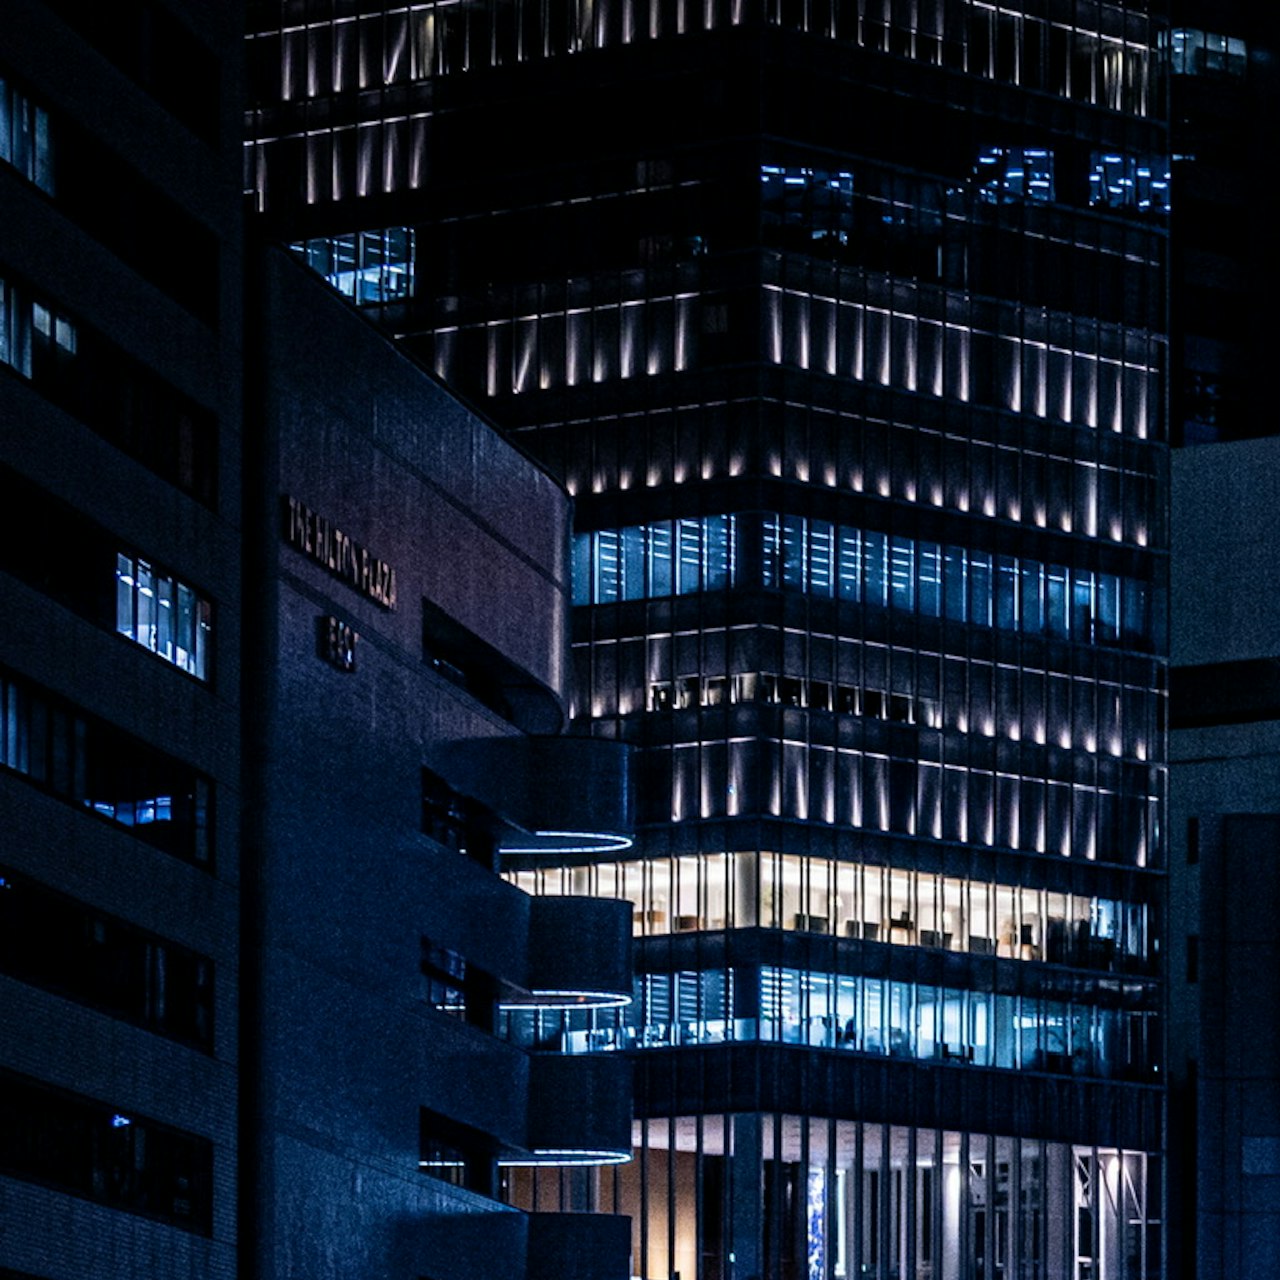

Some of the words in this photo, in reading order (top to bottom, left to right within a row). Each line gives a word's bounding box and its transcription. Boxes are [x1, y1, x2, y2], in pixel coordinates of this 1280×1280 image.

[289, 496, 312, 554] THE
[316, 514, 359, 585] HILTON
[362, 549, 398, 612] PLAZA
